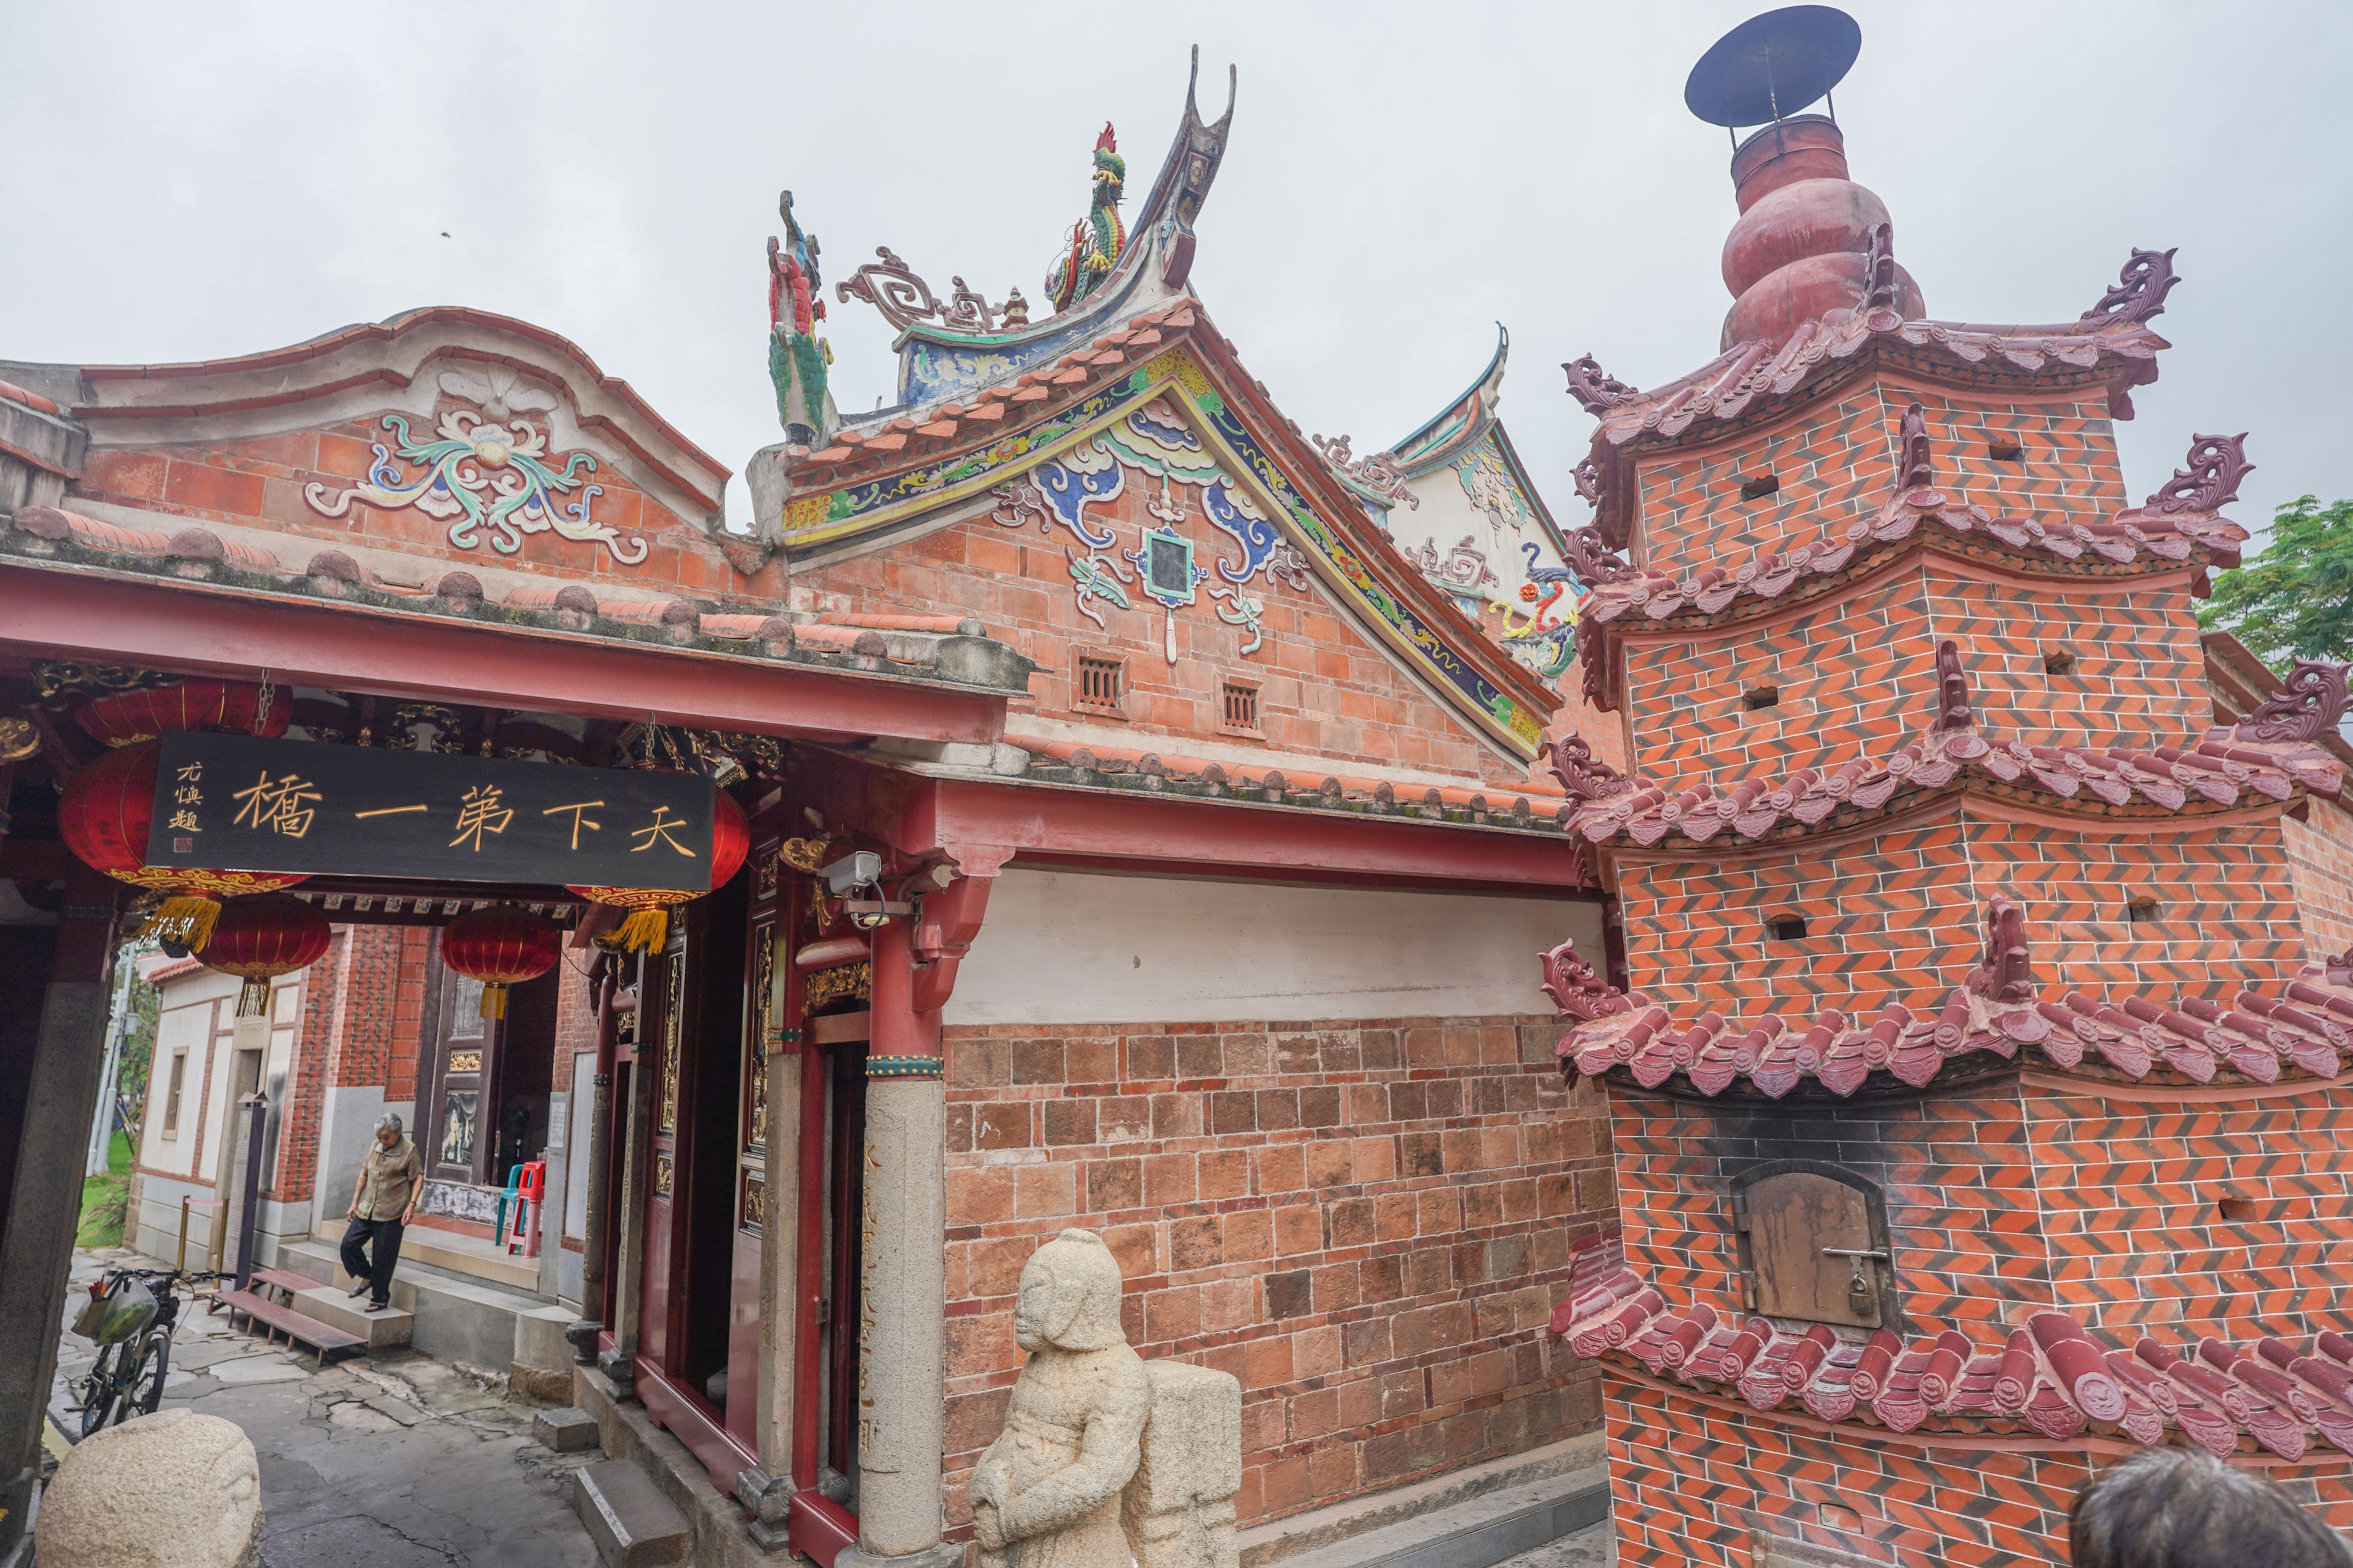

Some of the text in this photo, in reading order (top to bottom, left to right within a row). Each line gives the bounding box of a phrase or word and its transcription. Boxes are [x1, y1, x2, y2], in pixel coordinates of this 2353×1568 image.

[233, 771, 697, 857] 天下第一橋
